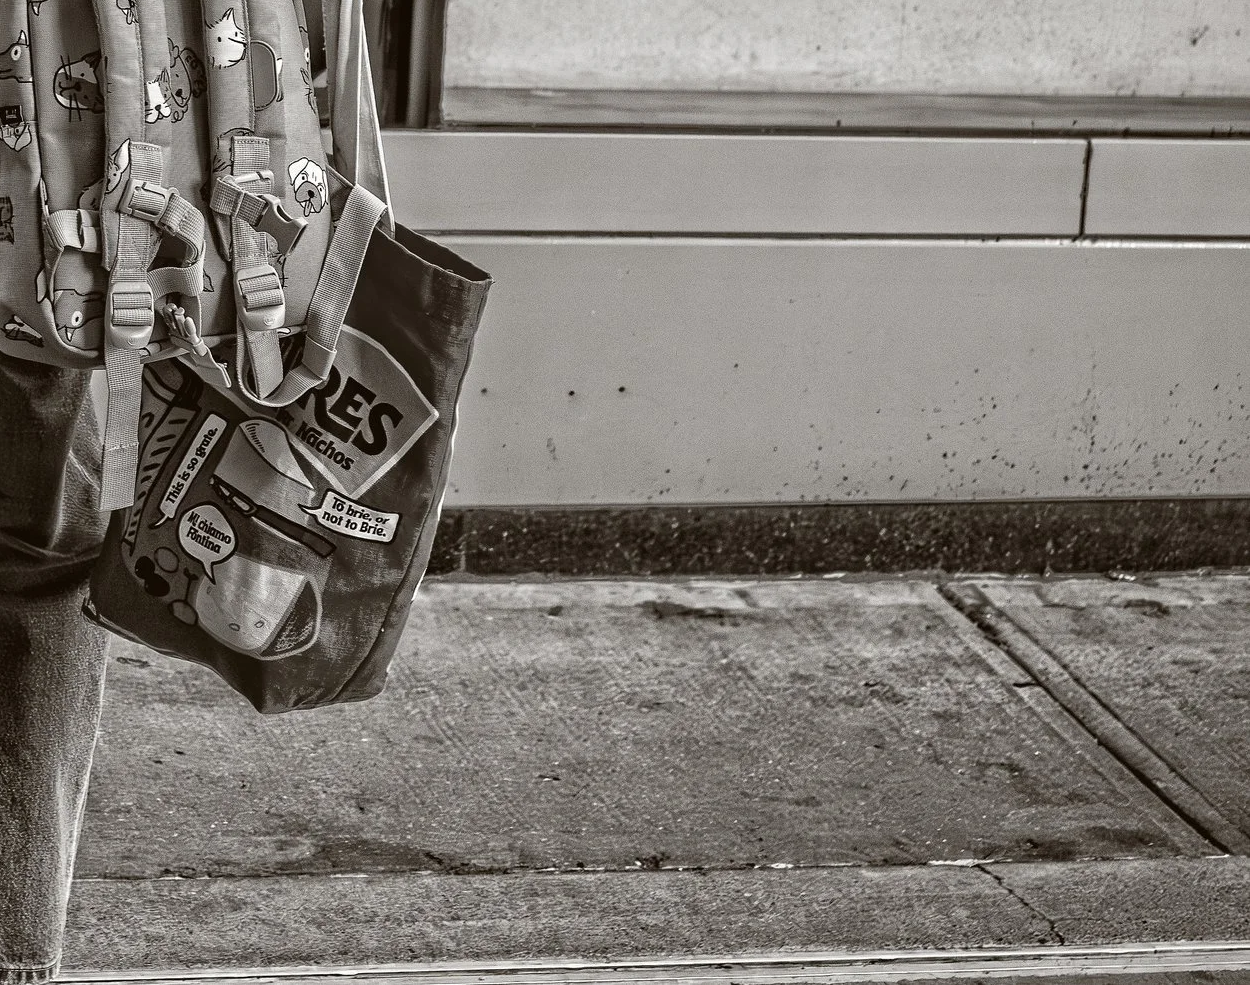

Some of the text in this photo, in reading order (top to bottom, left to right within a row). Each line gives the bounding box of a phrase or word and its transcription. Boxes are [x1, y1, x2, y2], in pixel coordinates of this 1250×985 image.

[296, 420, 354, 470] Nachos
[166, 427, 218, 504] This is so grate.
[322, 511, 387, 537] not to Brie.
[331, 496, 346, 512] To
[375, 516, 390, 525] or
[186, 526, 221, 554] Fontina
[198, 519, 232, 545] chiamo
